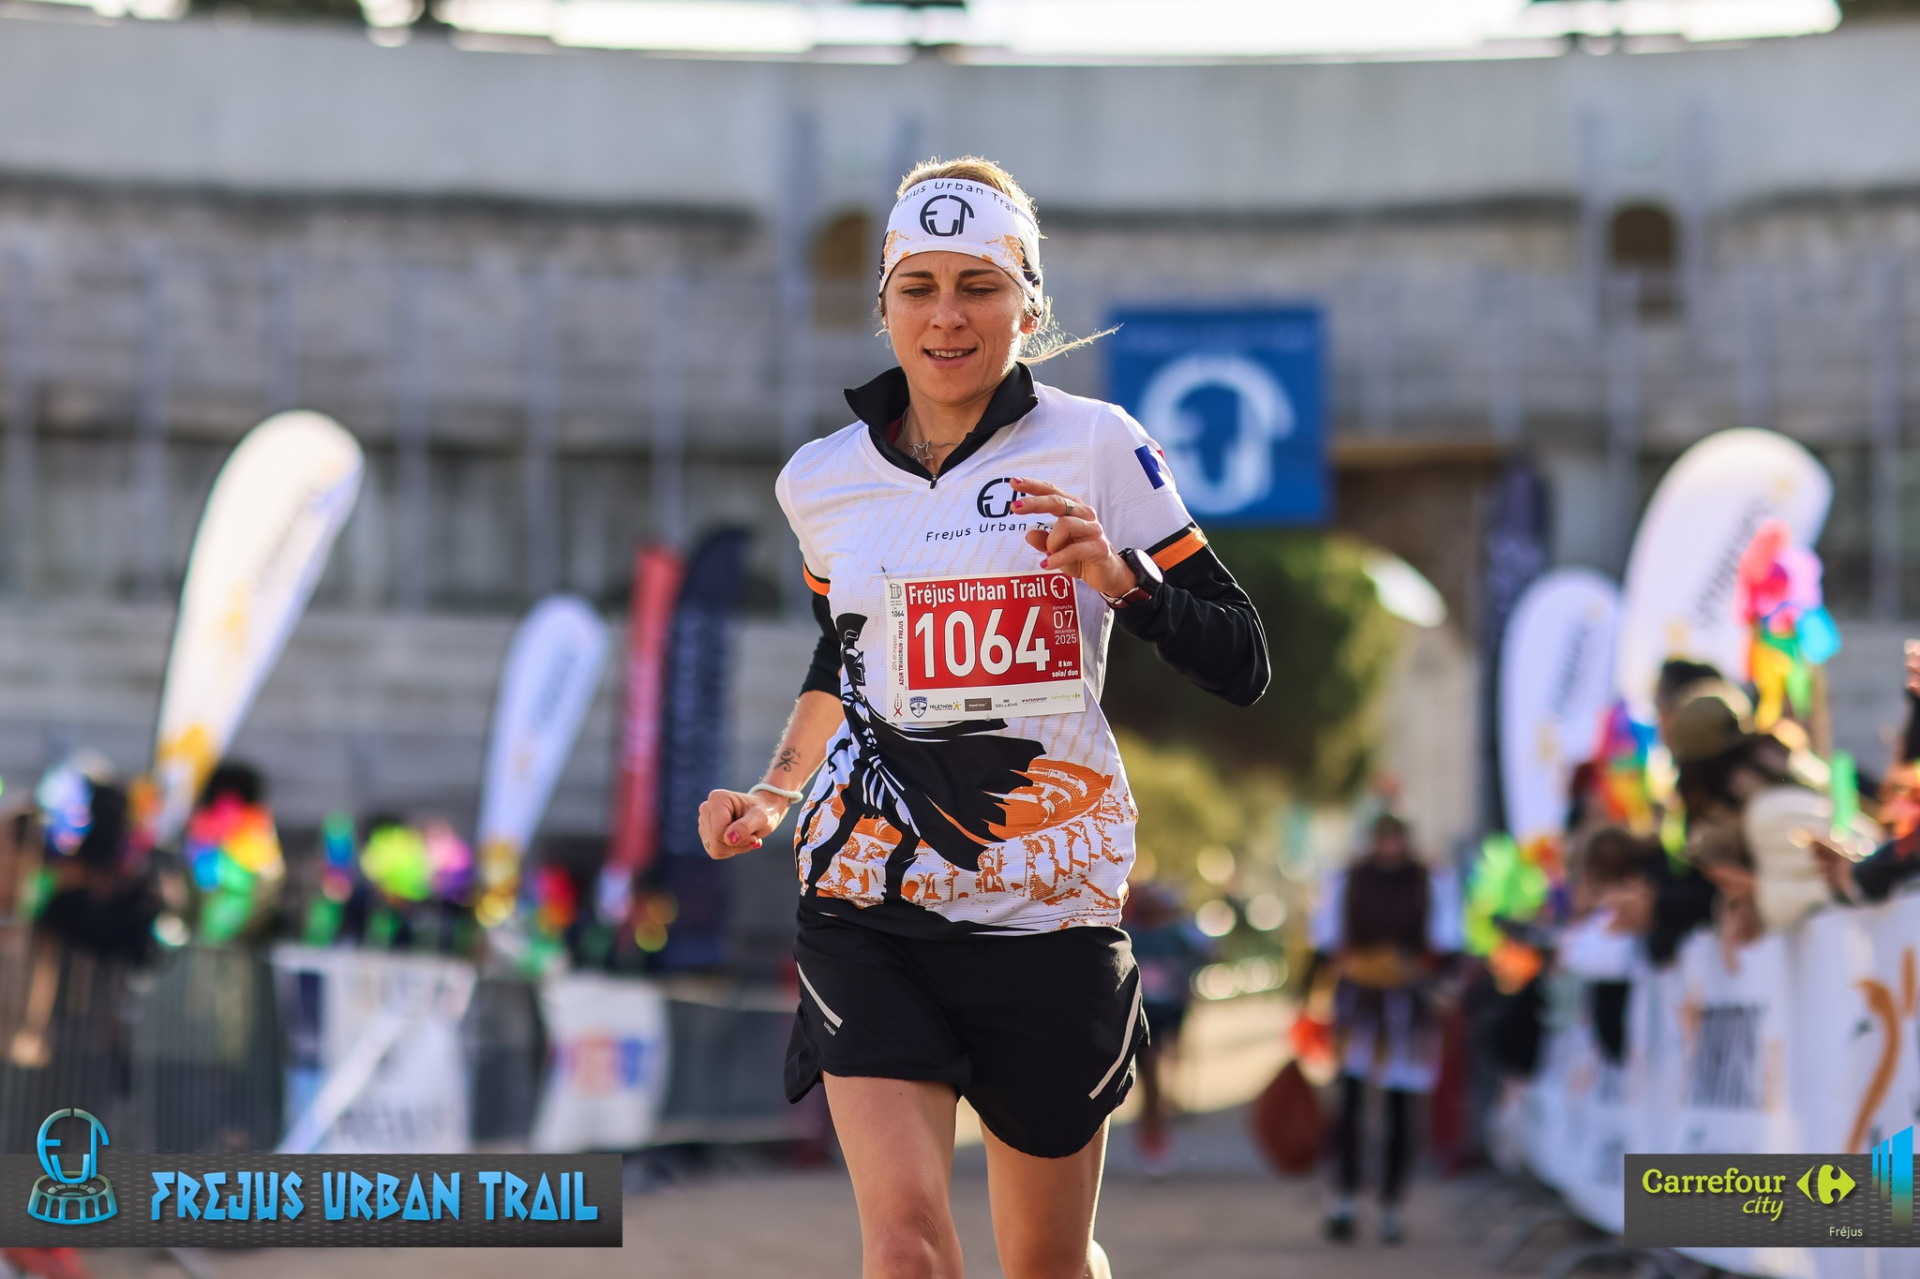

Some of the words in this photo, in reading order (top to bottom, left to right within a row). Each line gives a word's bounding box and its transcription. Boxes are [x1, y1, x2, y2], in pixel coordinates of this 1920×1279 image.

[934, 181, 984, 195] Urban
[991, 191, 1018, 215] Trail
[925, 526, 971, 542] Frejus
[979, 522, 1027, 533] Urban
[908, 584, 955, 608] Fréjus
[958, 581, 1007, 602] Urban
[1010, 577, 1048, 600] Trail
[1053, 610, 1074, 629] 07
[915, 605, 1051, 678] 1064
[1055, 634, 1077, 645] 2025
